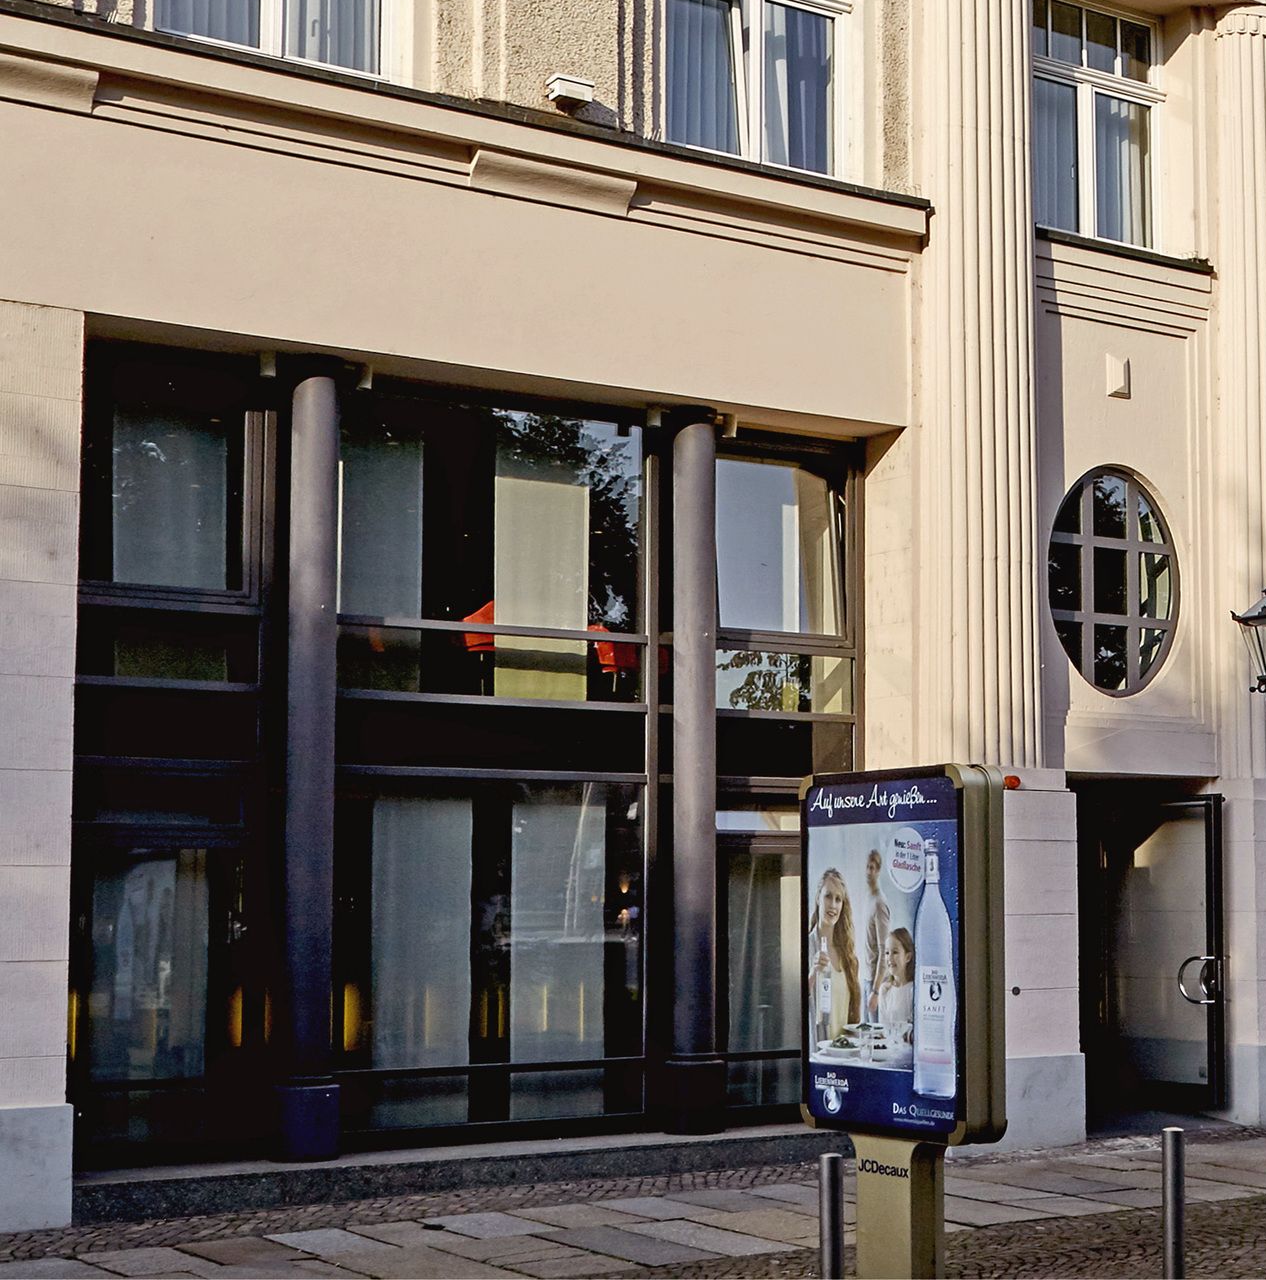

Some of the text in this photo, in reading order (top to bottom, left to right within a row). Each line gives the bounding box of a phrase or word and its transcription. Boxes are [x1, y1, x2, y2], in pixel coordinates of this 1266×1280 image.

[810, 787, 834, 819] Auf
[834, 794, 865, 809] unsere
[866, 783, 888, 808] Art
[858, 1158, 909, 1179] JCDecaux
